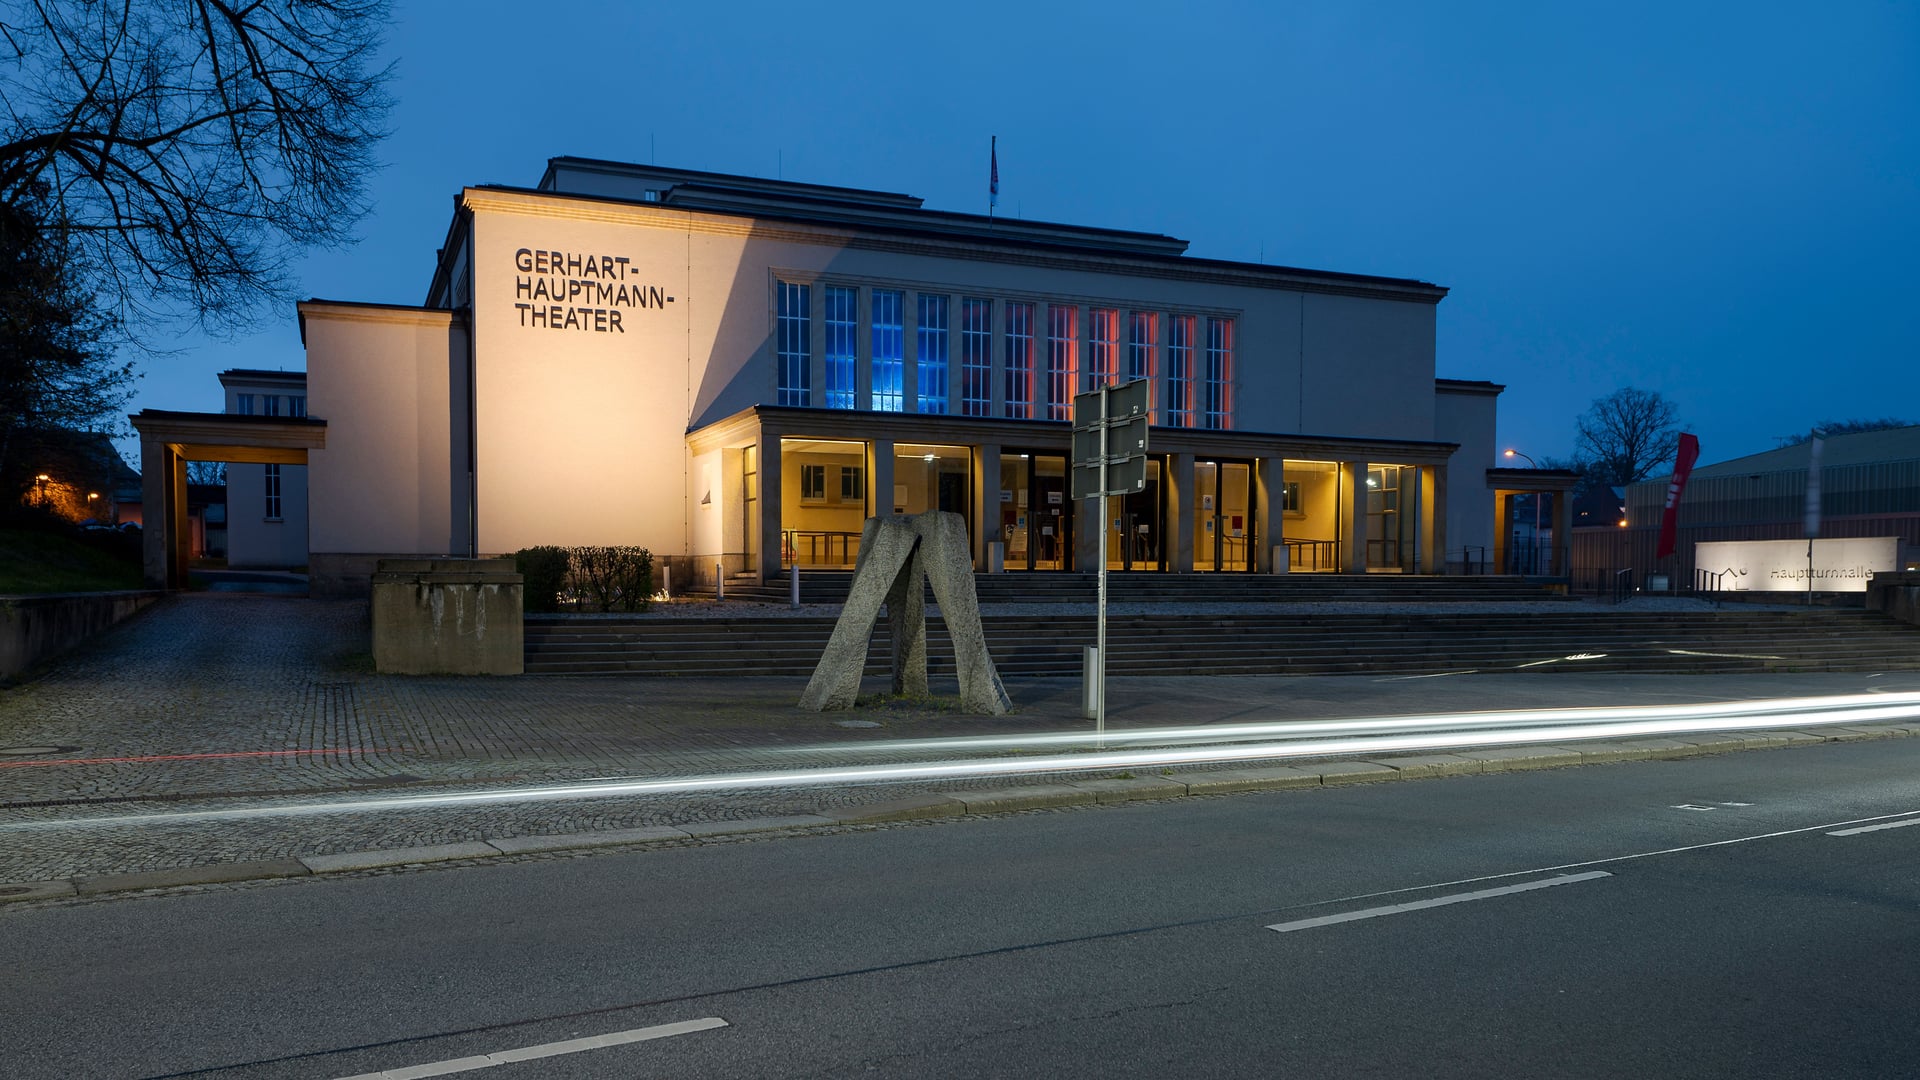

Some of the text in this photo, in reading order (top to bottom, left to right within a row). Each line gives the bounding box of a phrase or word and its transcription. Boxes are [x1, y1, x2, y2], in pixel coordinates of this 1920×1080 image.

[515, 248, 639, 280] GERHART-
[516, 275, 675, 309] HAUPTMANN-
[515, 303, 625, 333] THEATER
